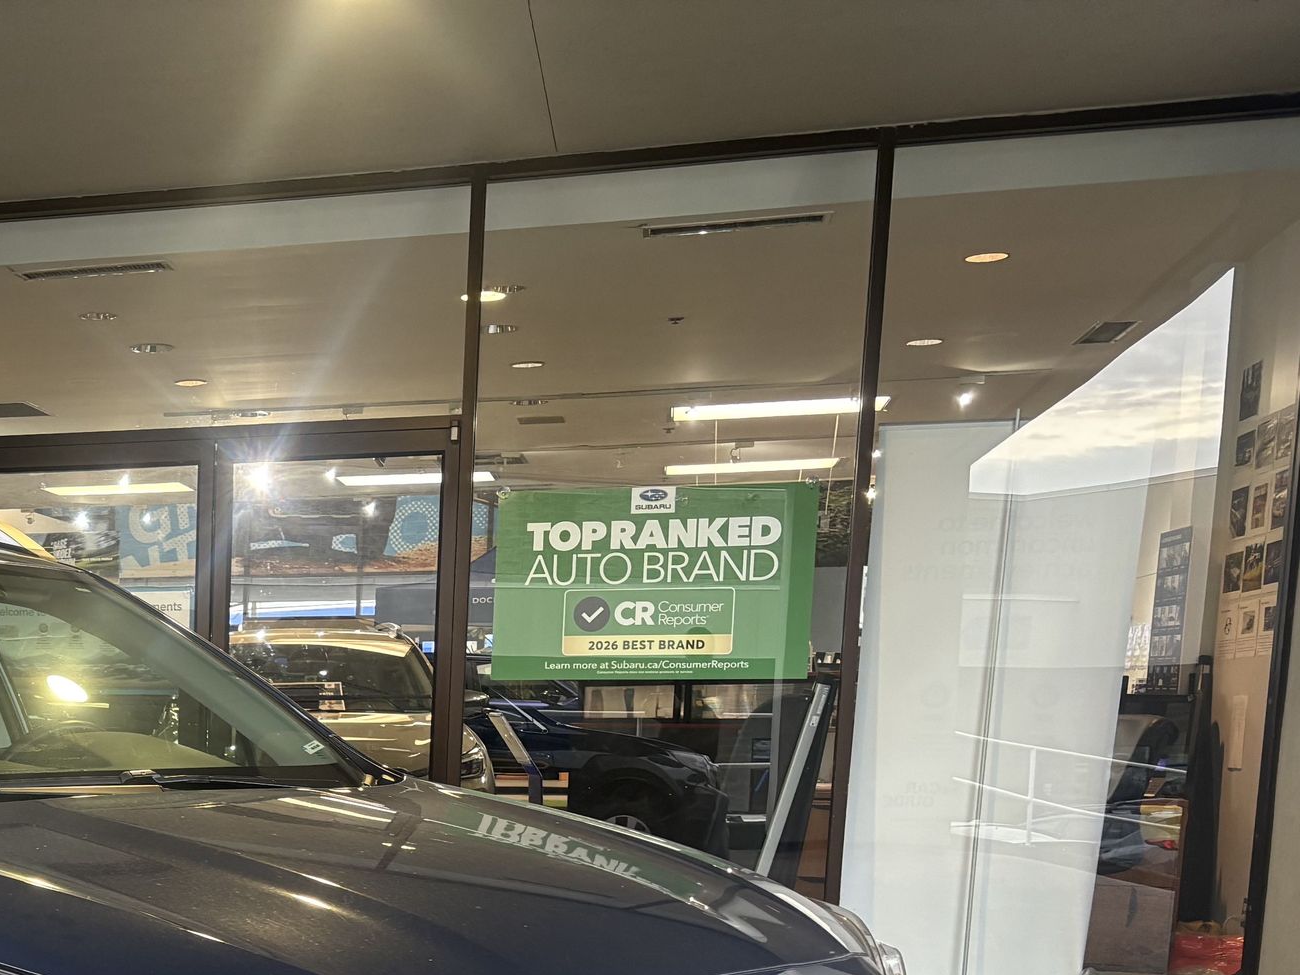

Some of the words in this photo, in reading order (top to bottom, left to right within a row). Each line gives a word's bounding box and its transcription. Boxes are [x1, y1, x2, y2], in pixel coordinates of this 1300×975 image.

[634, 503, 672, 511] SUBARU
[527, 522, 608, 552] TOP
[610, 516, 782, 550] RANKED
[524, 552, 632, 586] AUTO
[642, 549, 779, 583] BRAND
[658, 601, 724, 613] Consumer
[614, 601, 655, 626] CR
[588, 640, 618, 651] 2026
[622, 640, 655, 651] BEST
[658, 639, 705, 650] BRAND
[544, 661, 570, 671] Learn
[572, 663, 598, 671] more
[599, 662, 609, 670] at
[611, 660, 749, 672] Subaru.ca/ConsumerReports
